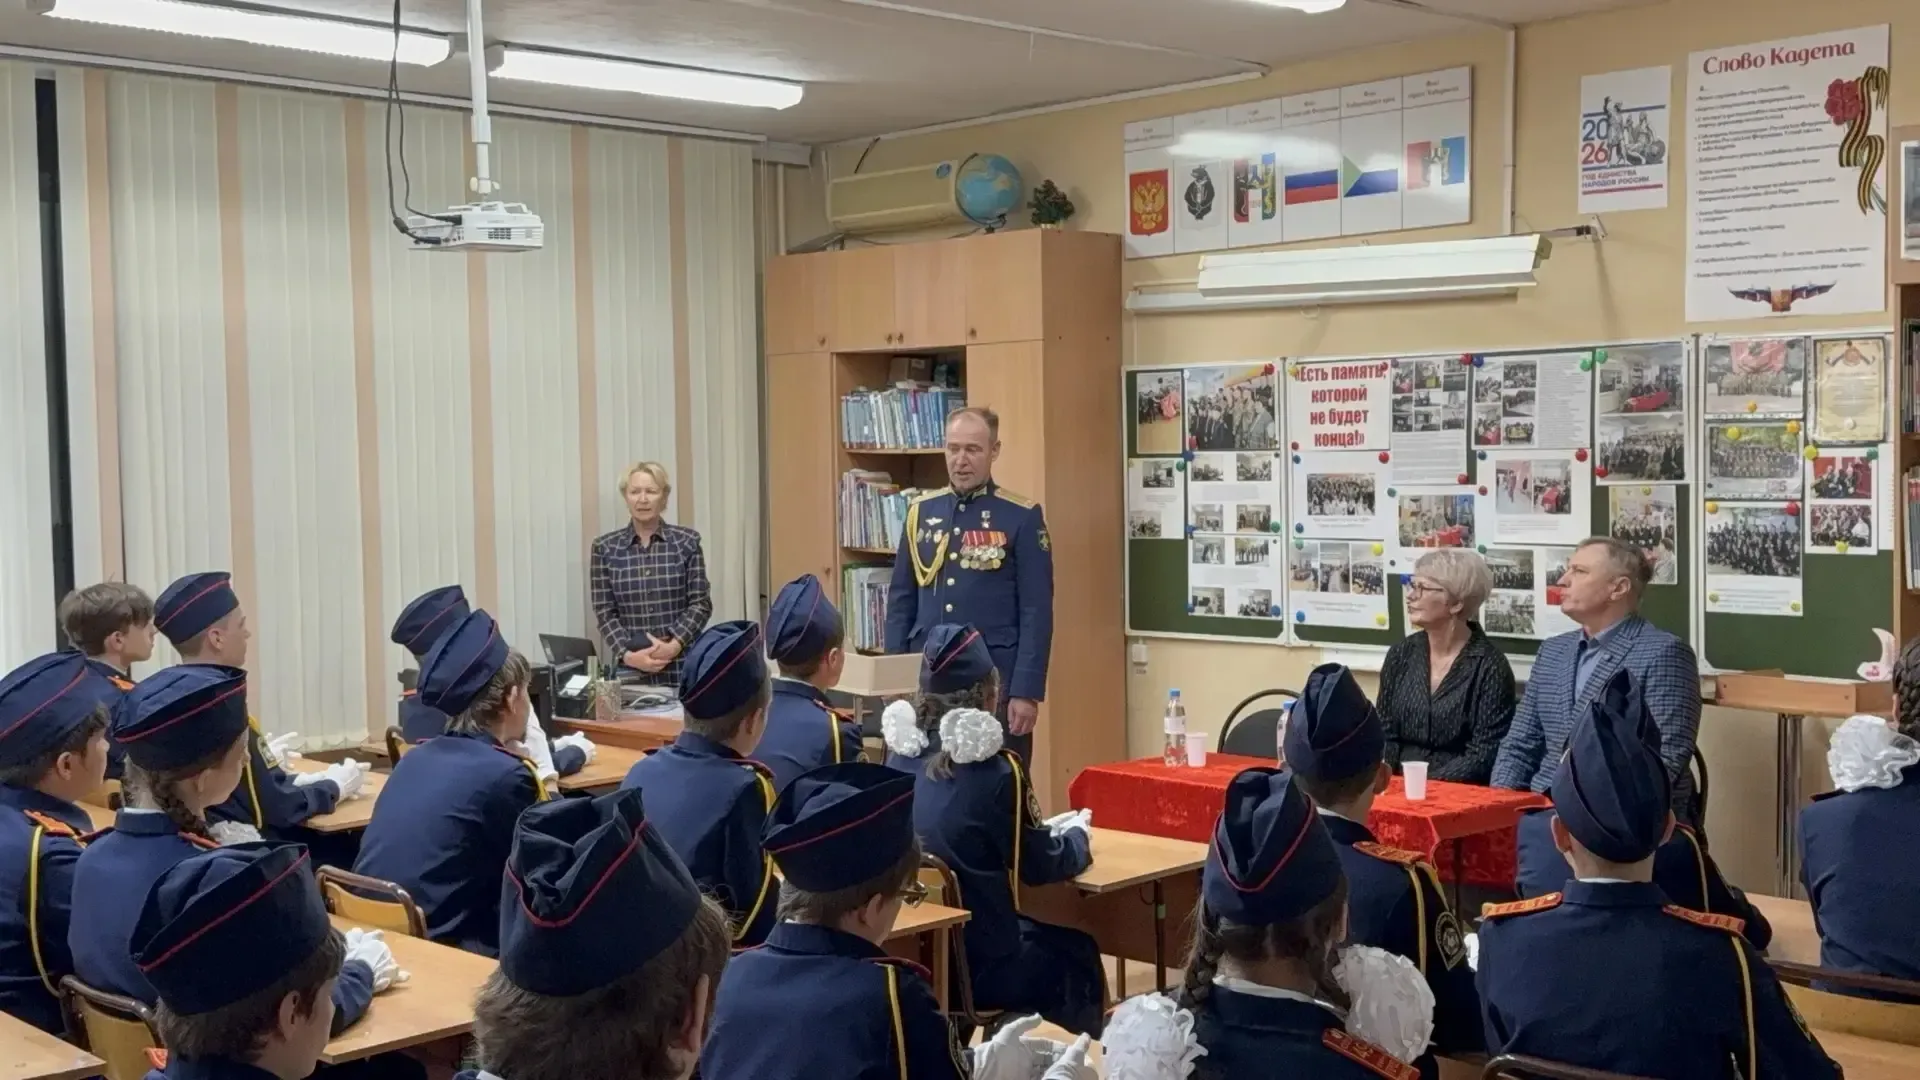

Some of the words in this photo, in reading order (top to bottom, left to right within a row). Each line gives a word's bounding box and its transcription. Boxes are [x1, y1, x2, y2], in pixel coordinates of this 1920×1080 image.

[1702, 51, 1765, 75] Слово
[1770, 41, 1856, 66] Кадета
[1582, 119, 1609, 141] 20
[1581, 142, 1608, 164] 26
[1311, 384, 1368, 404] которой
[1310, 411, 1326, 425] не
[1328, 408, 1369, 427] будет
[1314, 430, 1365, 448] конца!»
